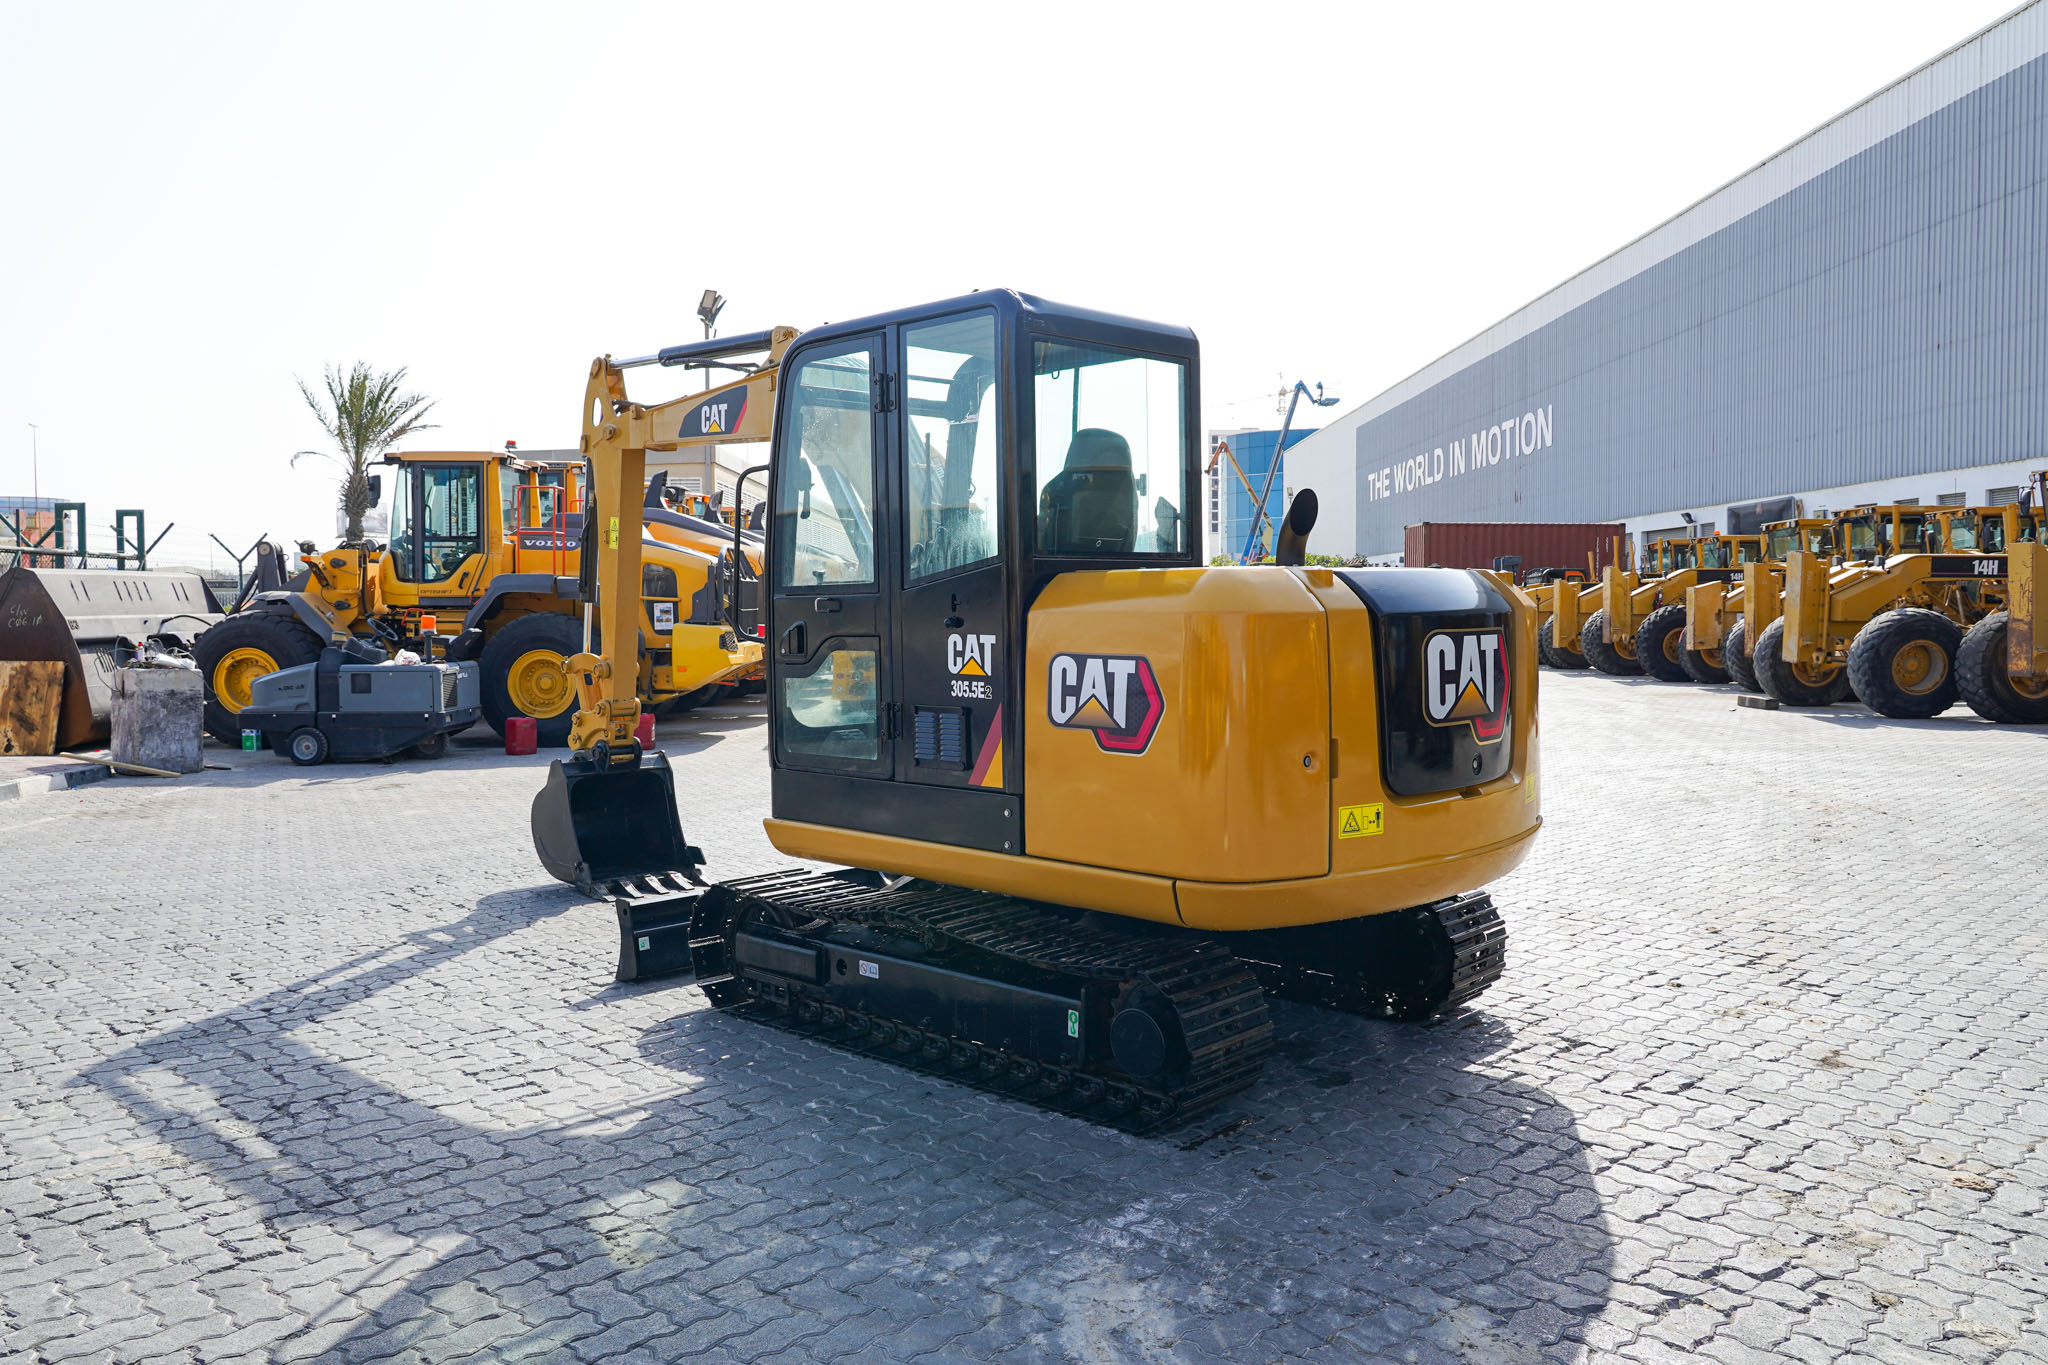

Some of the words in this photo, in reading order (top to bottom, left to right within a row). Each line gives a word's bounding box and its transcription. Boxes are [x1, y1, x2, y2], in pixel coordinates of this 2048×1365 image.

[701, 403, 728, 433] CAT
[1368, 467, 1390, 502] THE
[1394, 448, 1444, 494] WORLD
[1450, 438, 1466, 477] IN
[1472, 404, 1553, 470] MOTION
[524, 539, 577, 548] VOLVO
[1730, 572, 1744, 581] 14H
[1972, 559, 1999, 576] 14H
[947, 633, 997, 677] CAT
[950, 679, 993, 700] 305.5E2
[1427, 633, 1499, 720] CAT
[1051, 655, 1137, 729] CAT
